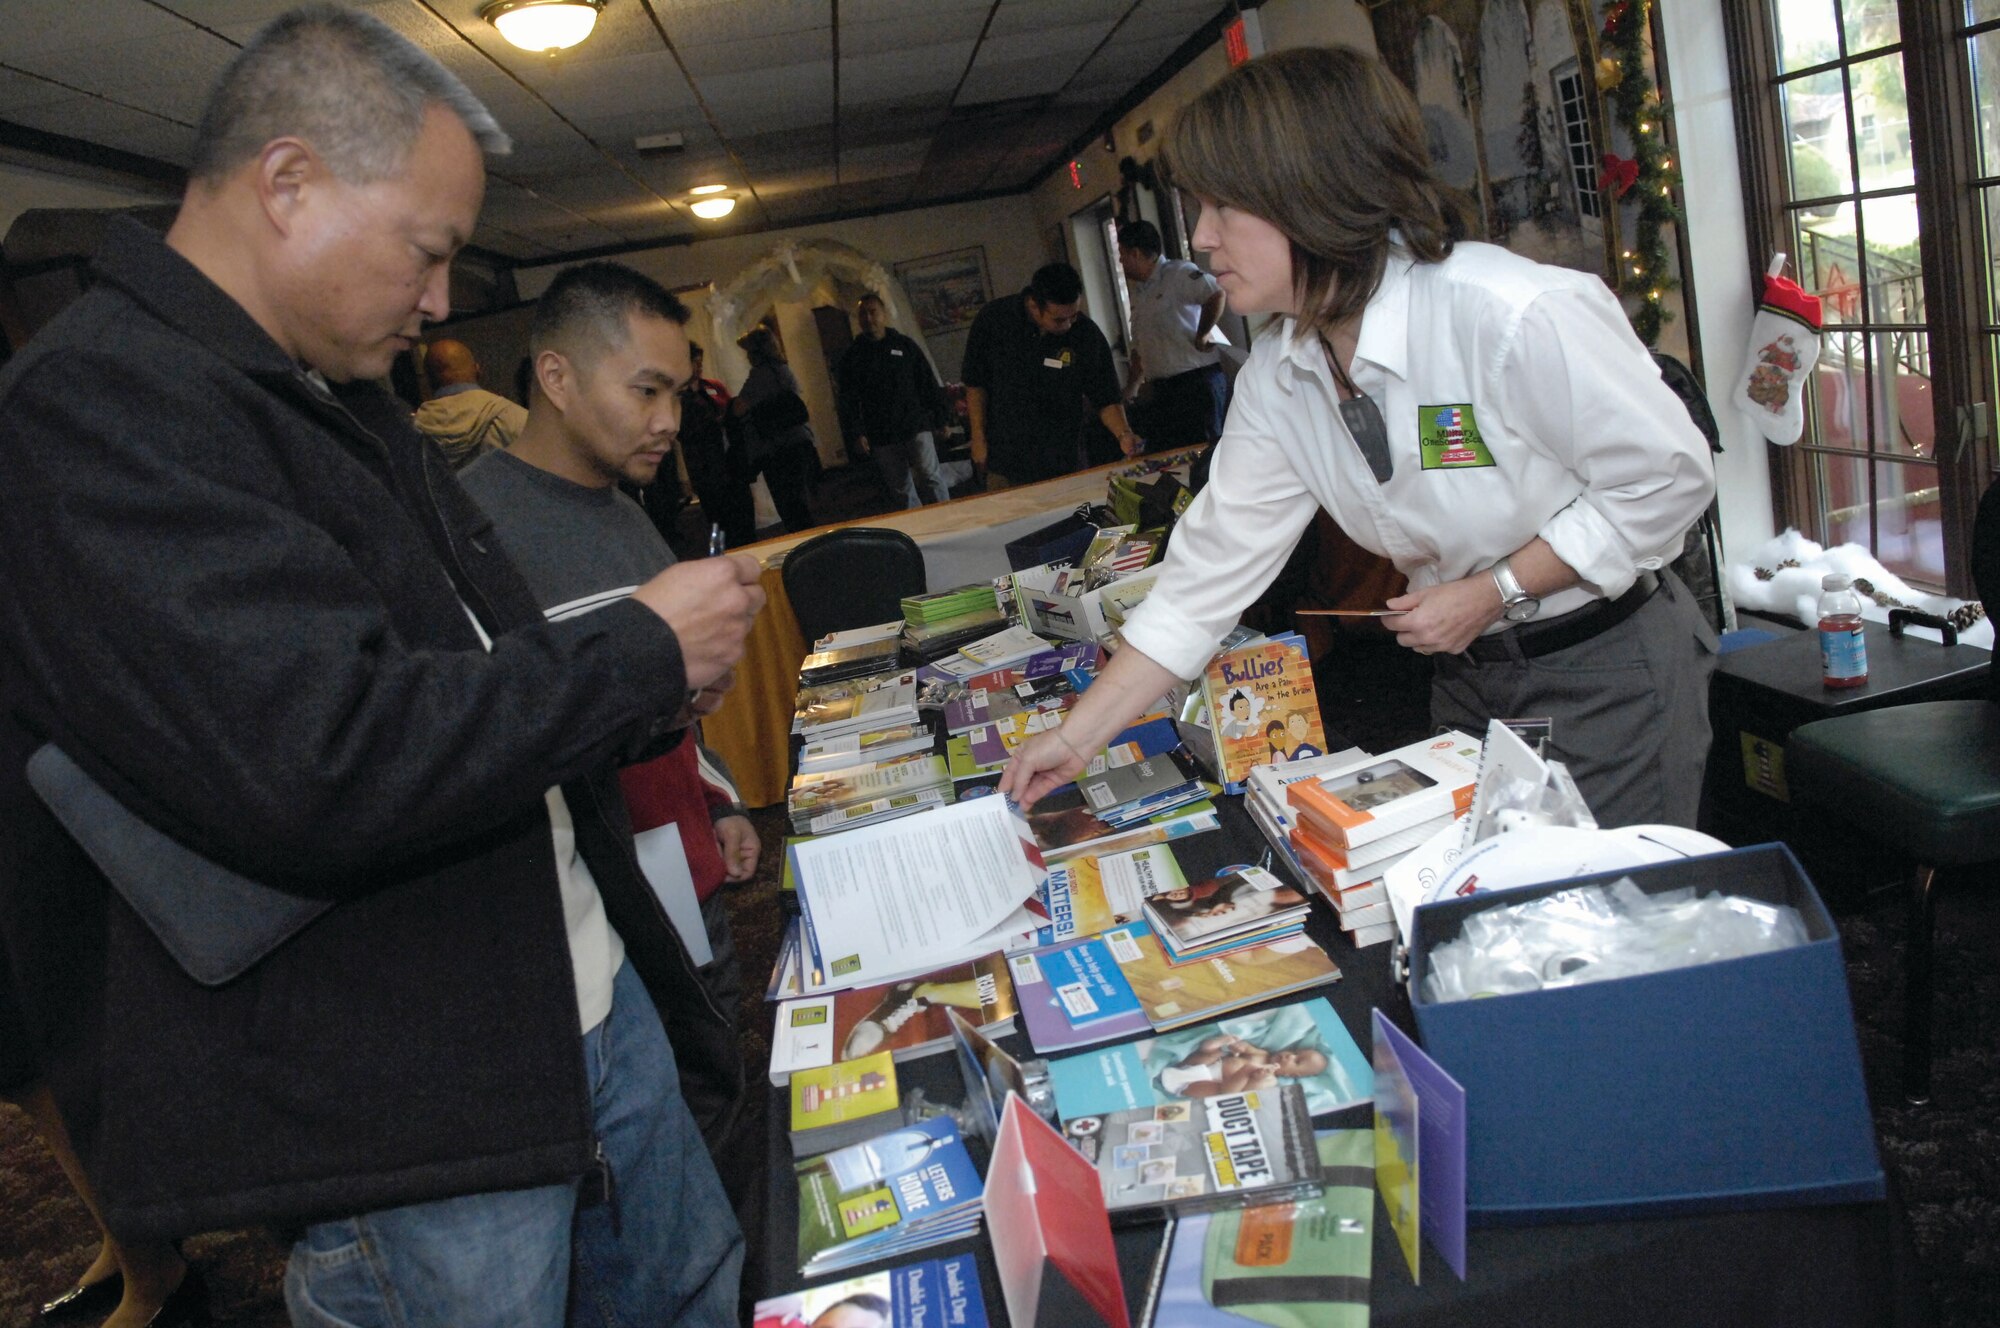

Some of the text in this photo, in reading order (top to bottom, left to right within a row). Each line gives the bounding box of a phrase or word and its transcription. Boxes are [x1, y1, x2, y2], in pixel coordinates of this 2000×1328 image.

[1221, 653, 1284, 684] Bullies
[1255, 682, 1269, 692] Are
[1278, 675, 1294, 687] Pain
[1267, 684, 1312, 701] in the Brain
[1050, 869, 1074, 936] MATTERS!
[1216, 1096, 1255, 1137] DUCT
[1230, 1138, 1269, 1180] TAPE
[896, 1171, 930, 1213] HOME
[927, 1163, 956, 1201] LETTERS
